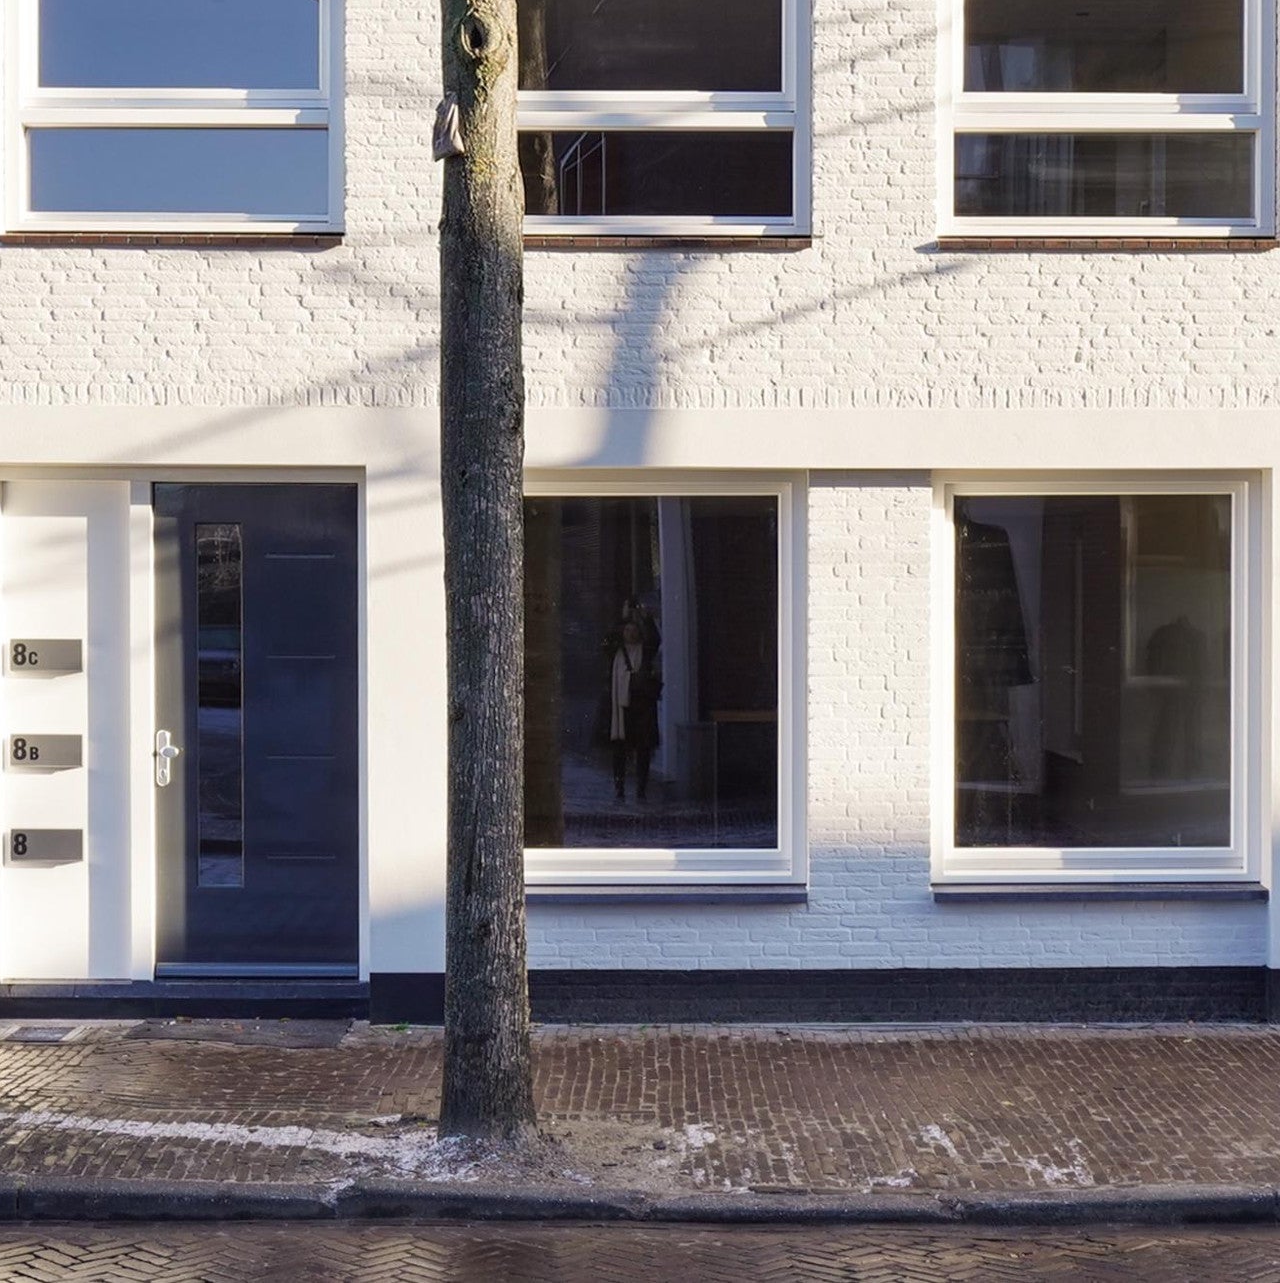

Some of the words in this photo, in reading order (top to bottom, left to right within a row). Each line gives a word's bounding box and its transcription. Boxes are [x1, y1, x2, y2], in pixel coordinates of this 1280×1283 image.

[13, 643, 38, 666] 8C
[13, 738, 39, 761] 8B
[13, 833, 27, 856] 8
